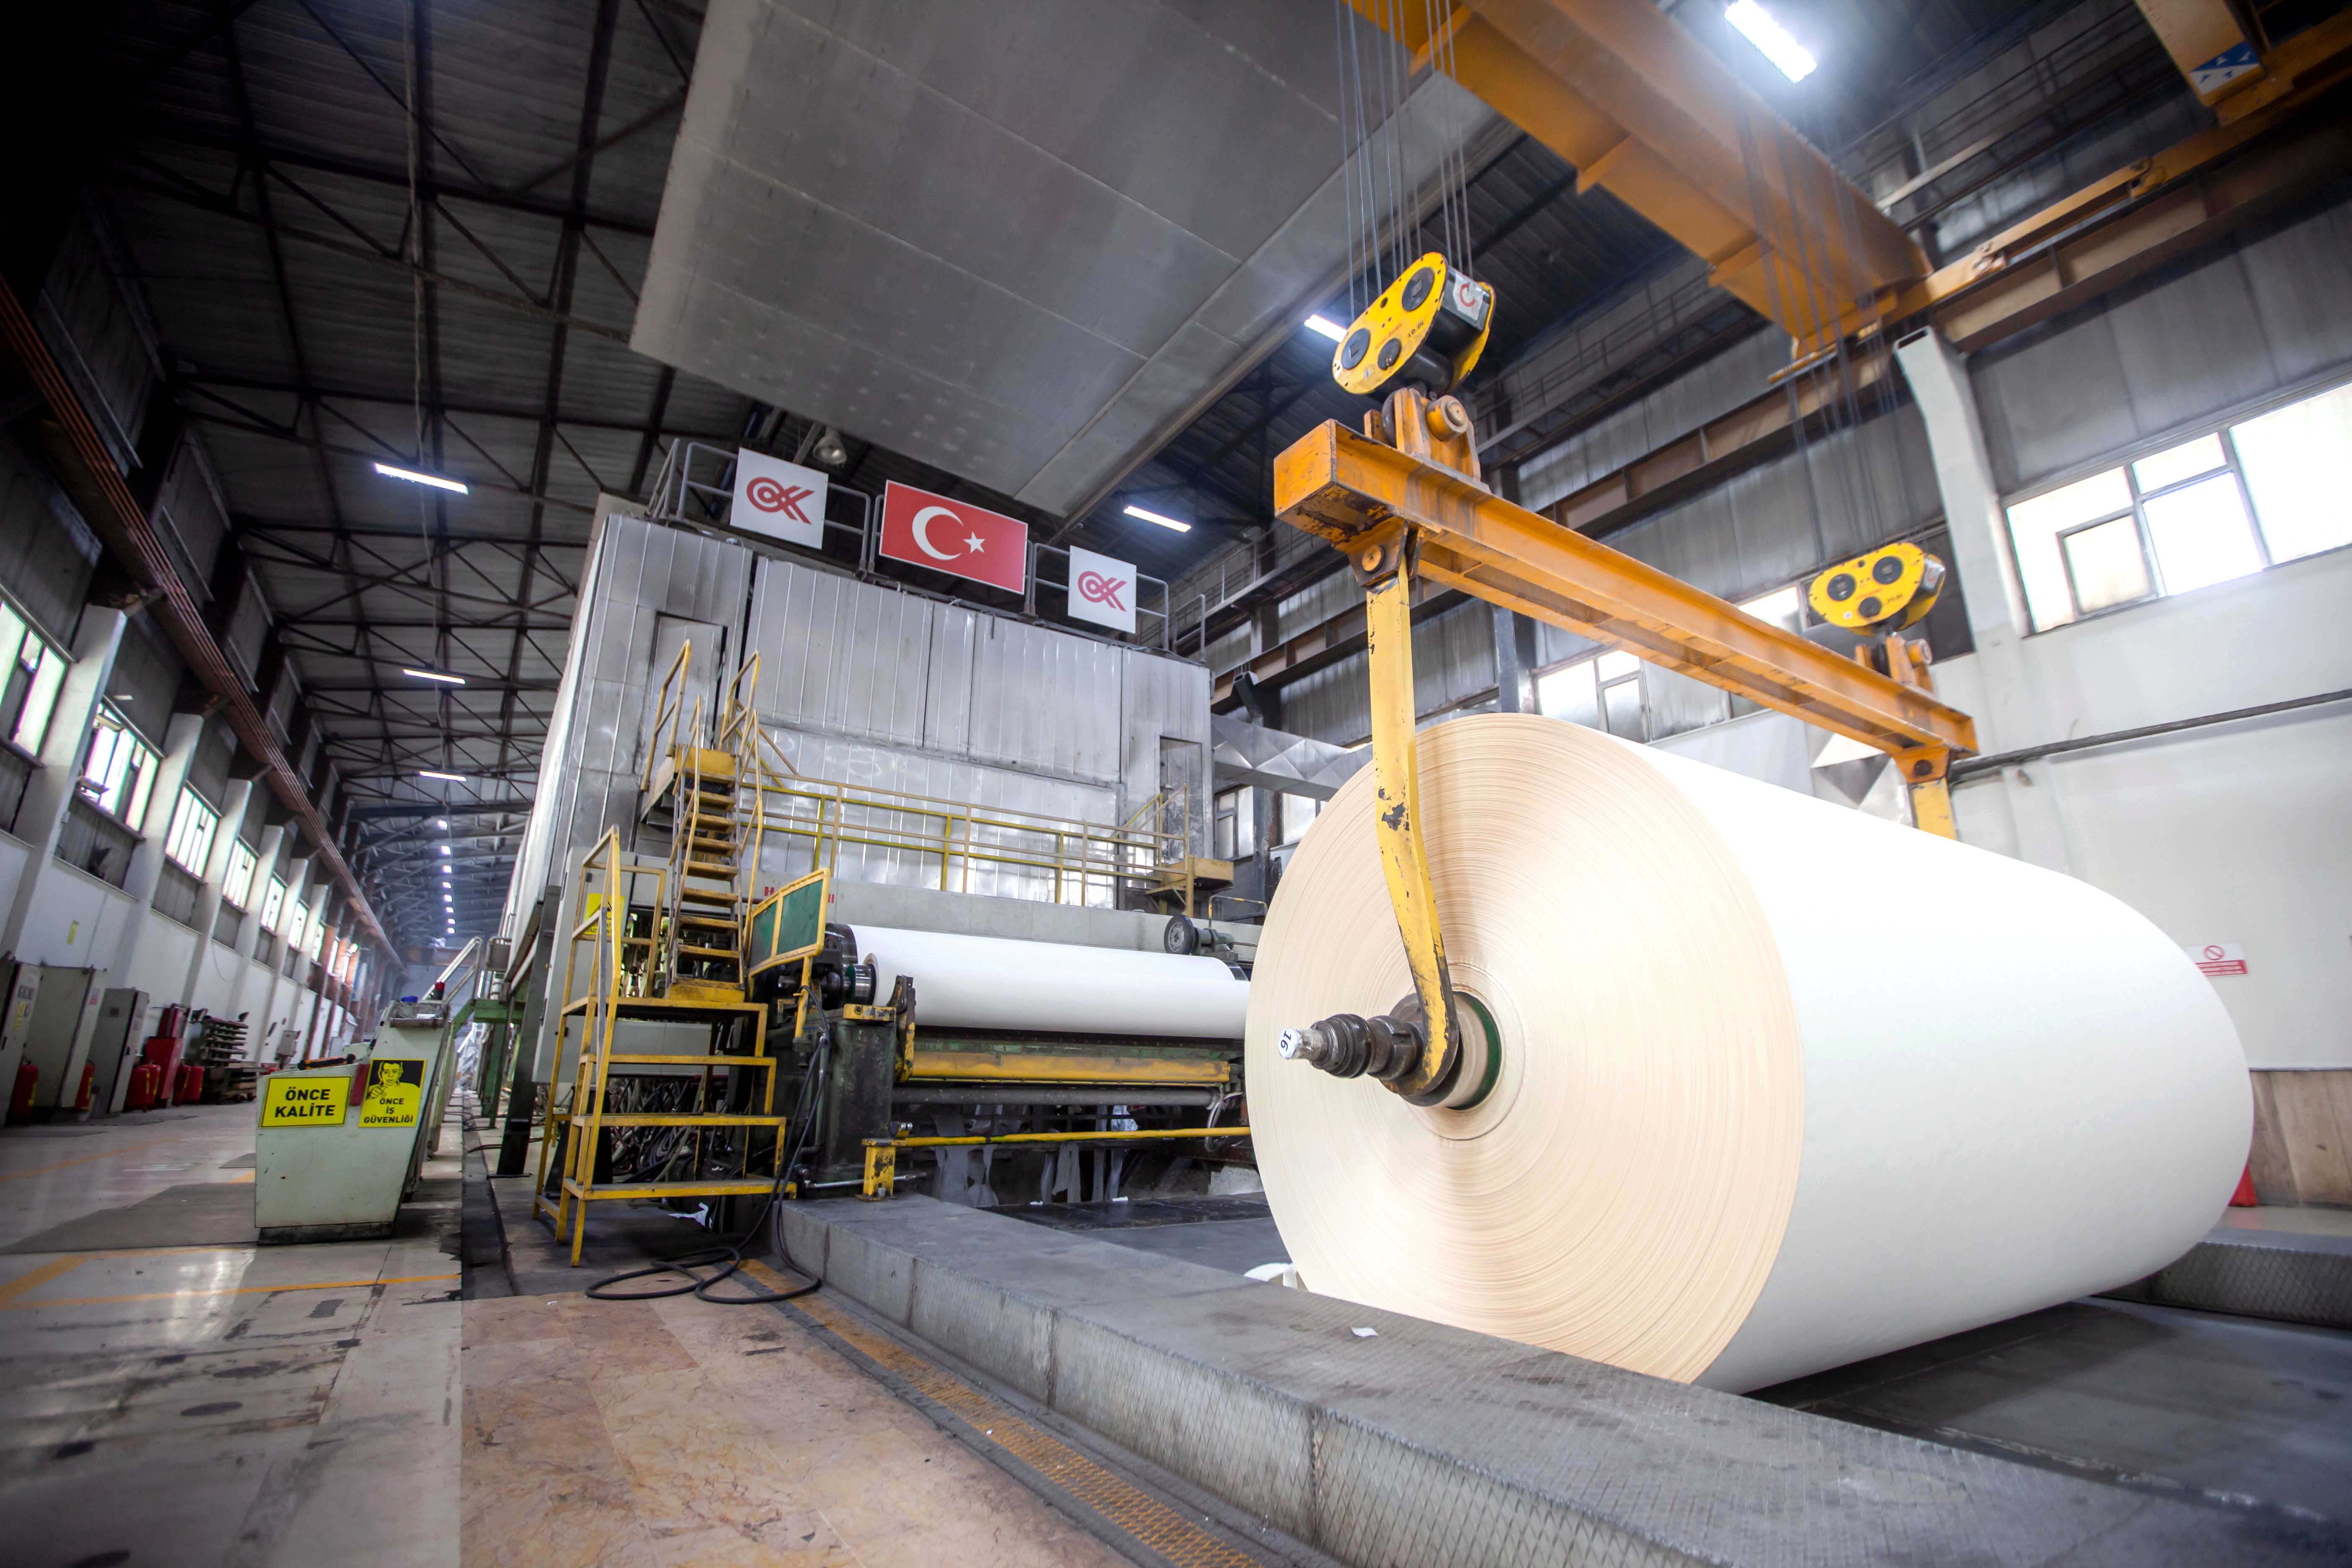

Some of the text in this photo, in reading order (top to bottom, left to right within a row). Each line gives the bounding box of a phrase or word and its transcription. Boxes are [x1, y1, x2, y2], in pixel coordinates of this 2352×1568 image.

[1281, 1030, 1292, 1051] 16
[285, 1086, 331, 1101] ÖNCE
[379, 1096, 405, 1105] ÖNCE
[275, 1103, 335, 1118] KALİTE
[386, 1106, 395, 1114] İŞ
[364, 1115, 413, 1123] GÜVENLİĞİ
